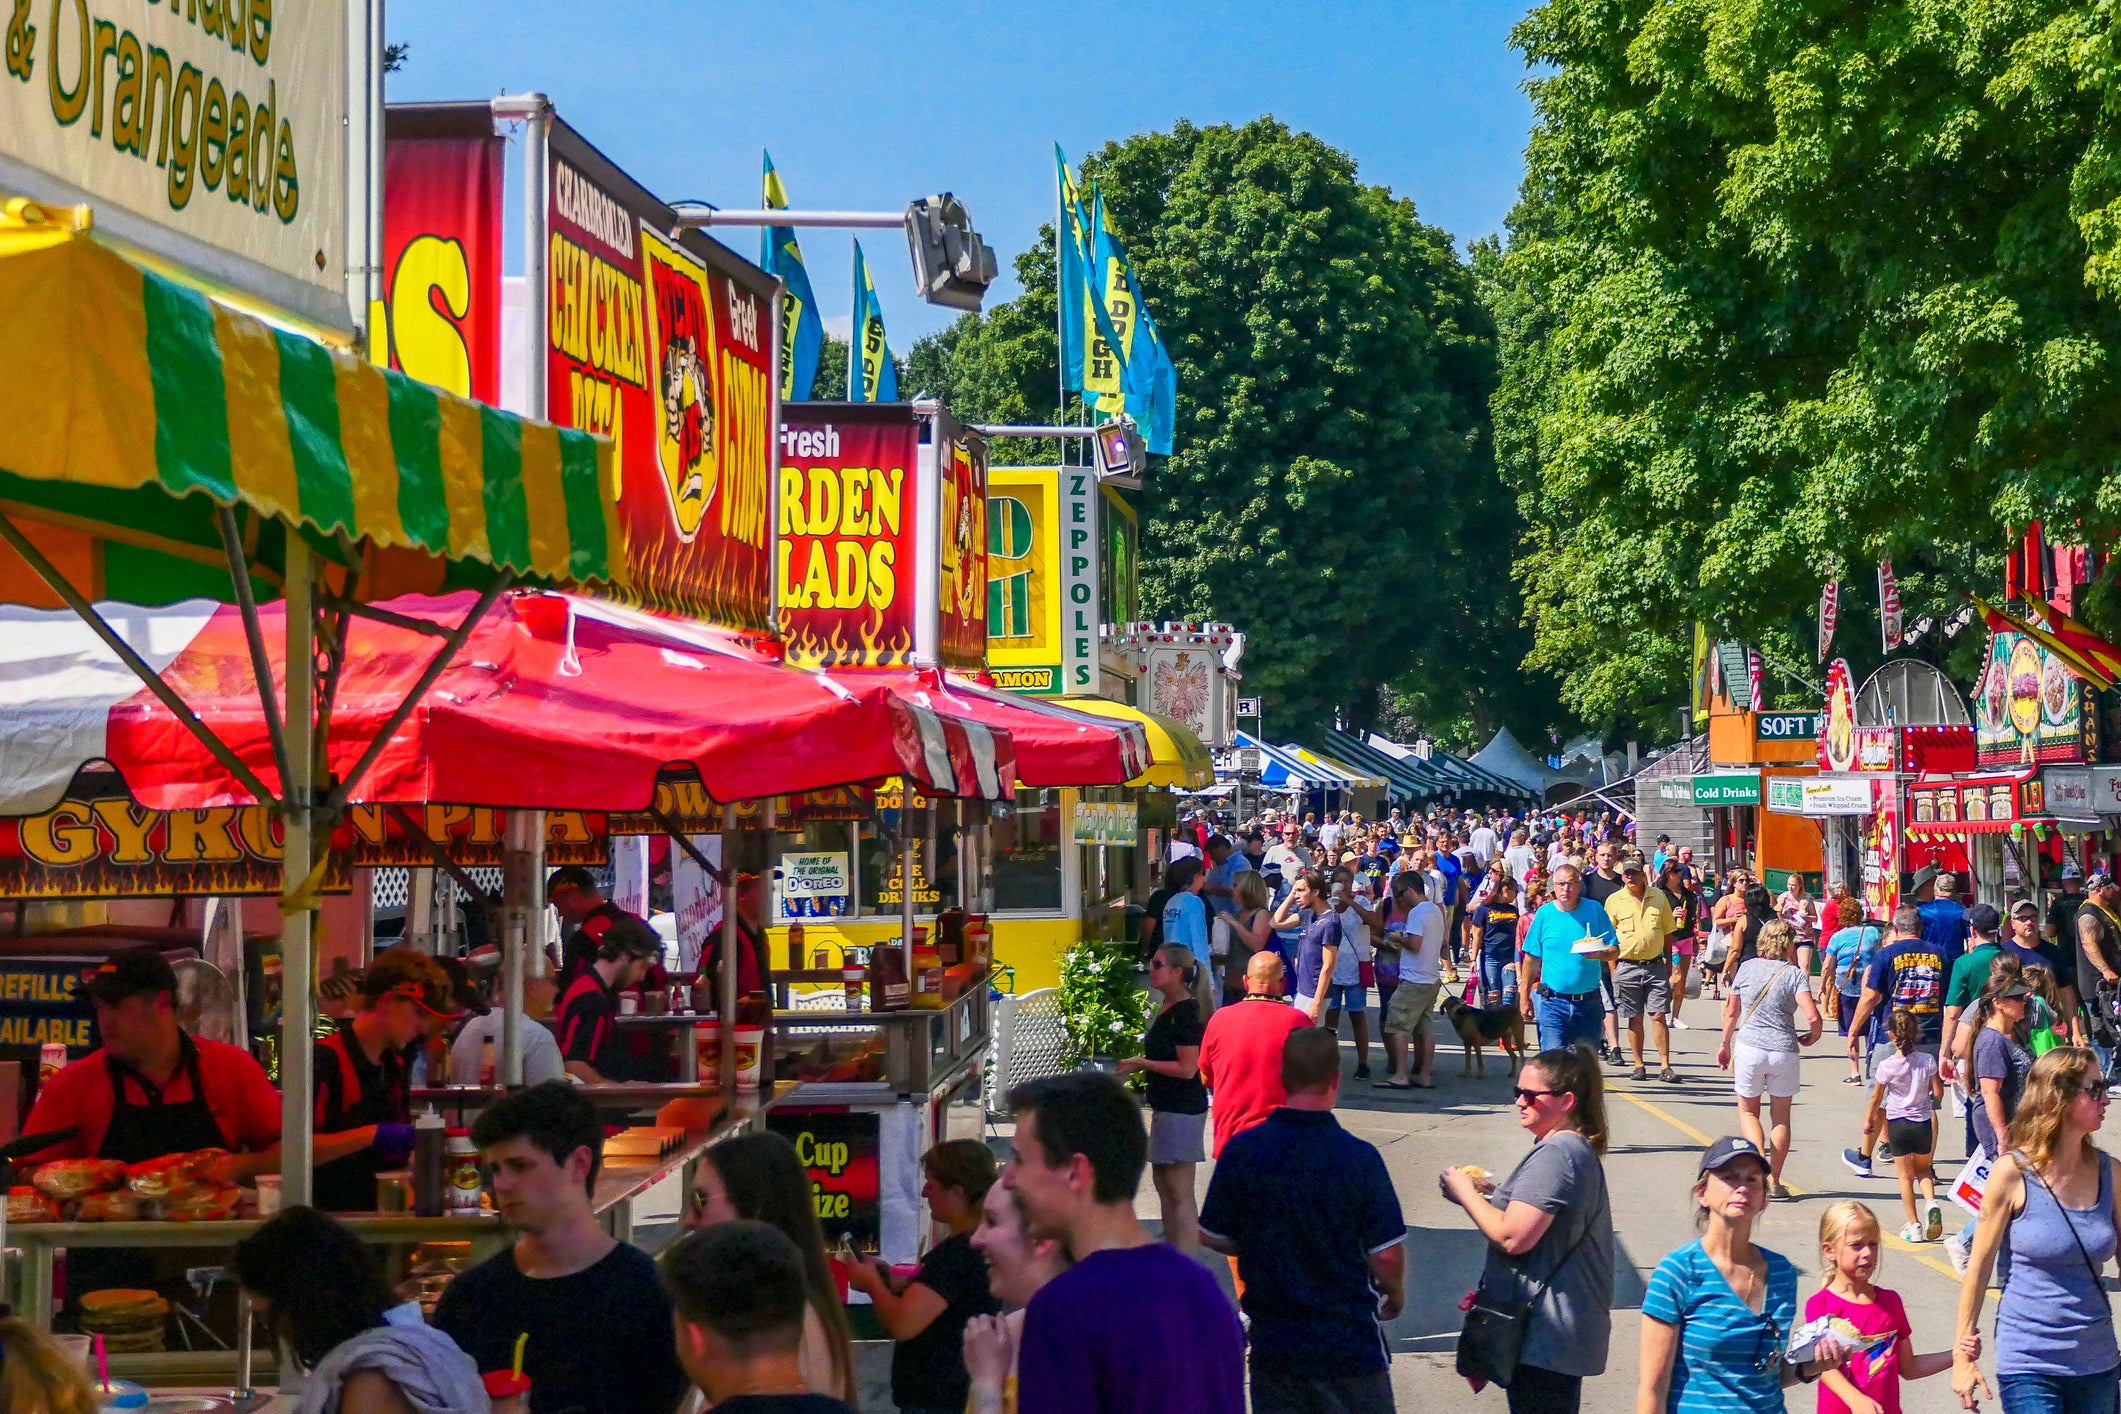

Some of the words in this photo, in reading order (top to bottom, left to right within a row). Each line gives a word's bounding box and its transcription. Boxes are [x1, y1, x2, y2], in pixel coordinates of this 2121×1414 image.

[48, 0, 299, 224] Orangeade
[555, 159, 635, 262] CHARBROILED
[551, 231, 647, 396] CHICKEN
[727, 278, 759, 353] Greek
[721, 345, 768, 551] GYROS
[1070, 475, 1091, 685] ZEPPOLES
[1760, 717, 1807, 735] SOFT
[1695, 787, 1719, 799] Cold
[1722, 786, 1758, 798] Drinks
[427, 802, 593, 843] PIA
[793, 866, 807, 875] THE
[799, 857, 820, 866] HOME
[822, 856, 833, 865] OF
[788, 876, 844, 892] D'OREO
[795, 1131, 848, 1174] Cup
[813, 1183, 849, 1218] ize
